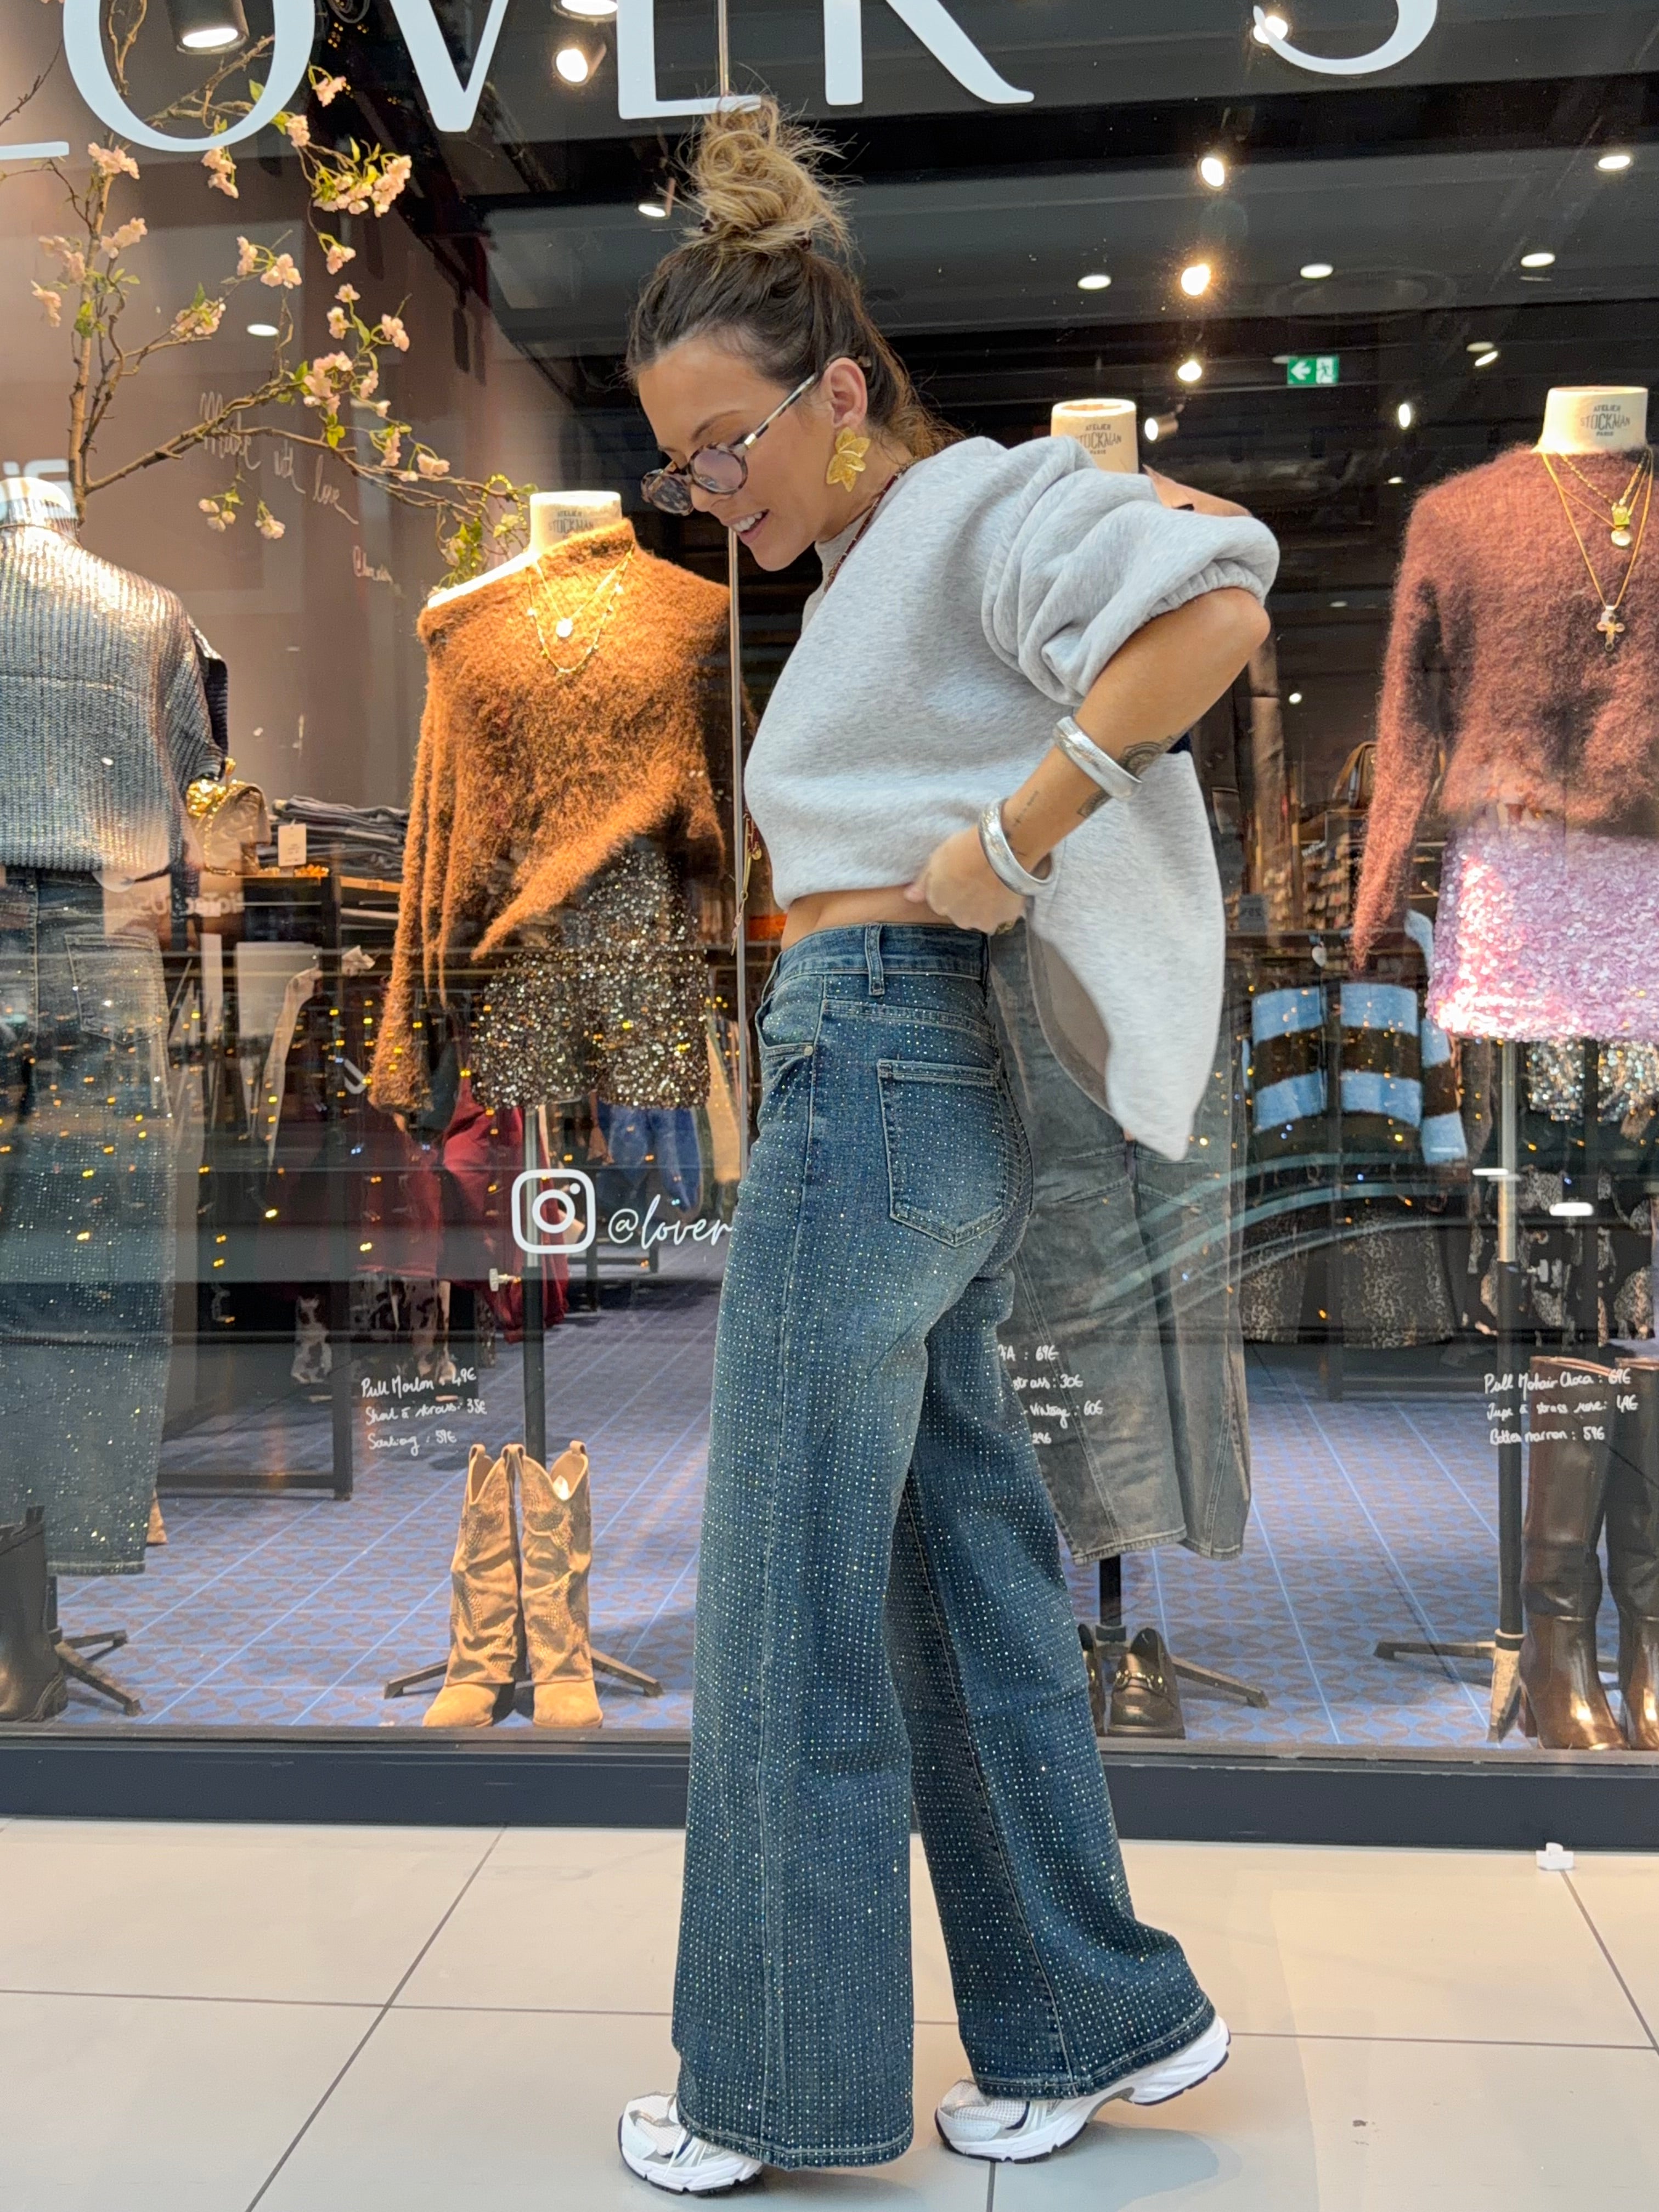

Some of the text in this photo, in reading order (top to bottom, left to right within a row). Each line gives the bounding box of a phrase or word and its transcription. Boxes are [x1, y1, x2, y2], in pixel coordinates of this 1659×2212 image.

[1594, 404, 1621, 412] ATELIER
[1580, 413, 1630, 431] STOCKMAN
[1076, 432, 1122, 449] TOCKMAN
[361, 1377, 389, 1398] Pull
[452, 1367, 477, 1386] 49€
[1484, 1373, 1514, 1394] Pull
